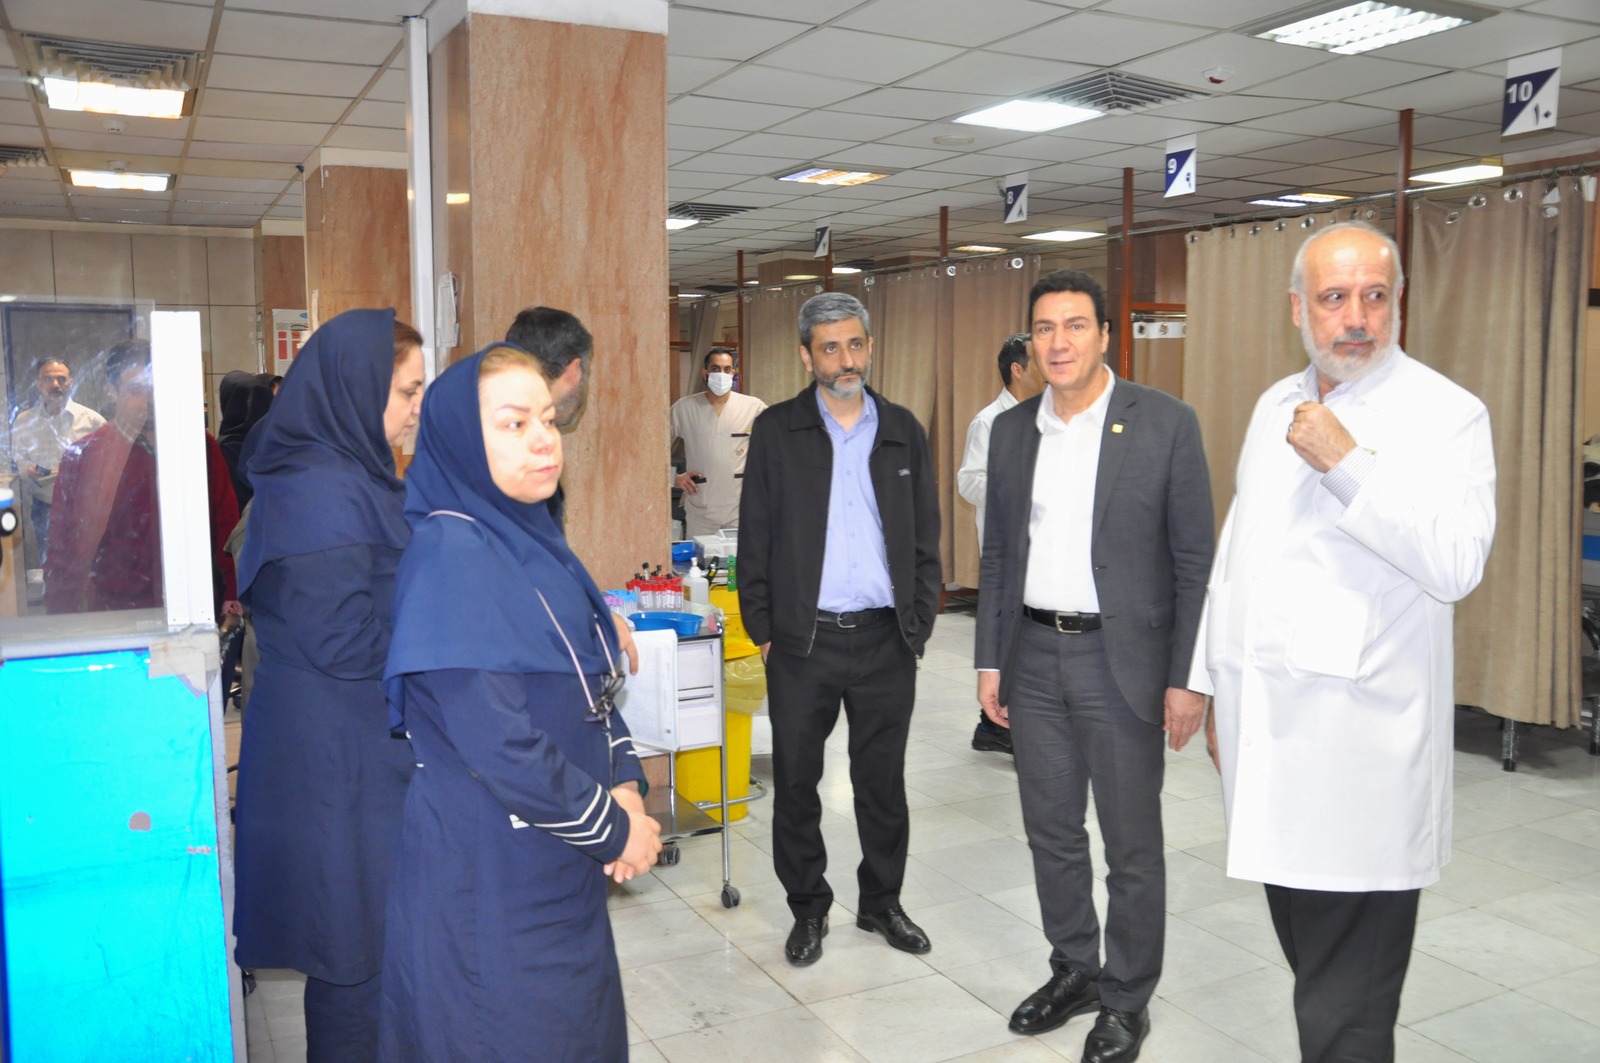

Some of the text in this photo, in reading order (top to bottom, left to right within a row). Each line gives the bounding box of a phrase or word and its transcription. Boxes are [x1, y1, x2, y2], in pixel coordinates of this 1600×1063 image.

[1506, 80, 1533, 104] 10
[1534, 103, 1551, 126] ۱۰
[1167, 158, 1177, 175] 9
[1006, 190, 1014, 205] 8
